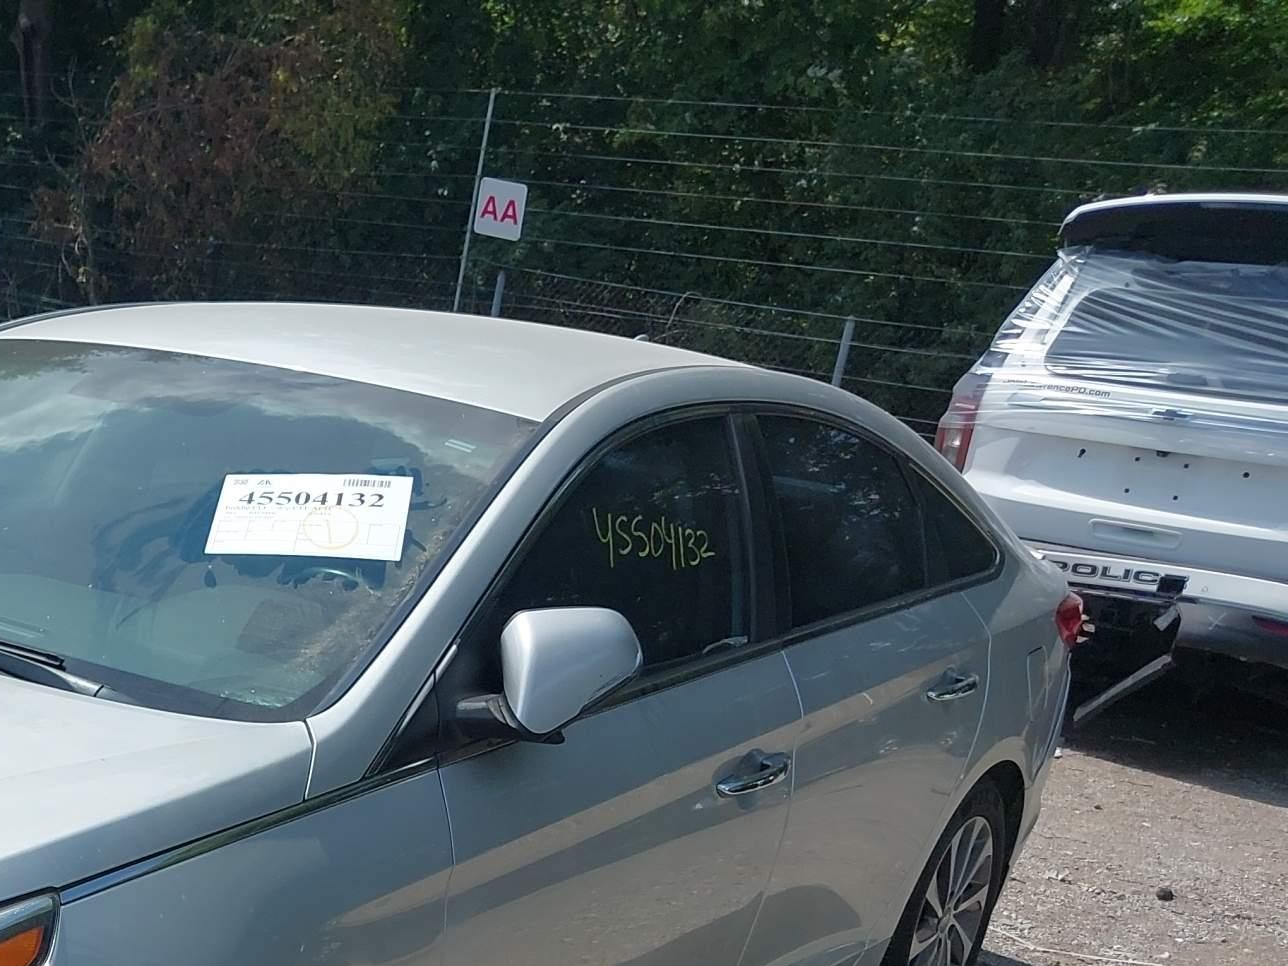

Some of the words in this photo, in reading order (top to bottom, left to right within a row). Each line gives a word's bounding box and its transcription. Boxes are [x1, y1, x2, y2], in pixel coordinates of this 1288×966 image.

[480, 195, 518, 226] AA
[238, 490, 385, 508] 45504132
[592, 507, 715, 570] 45504132
